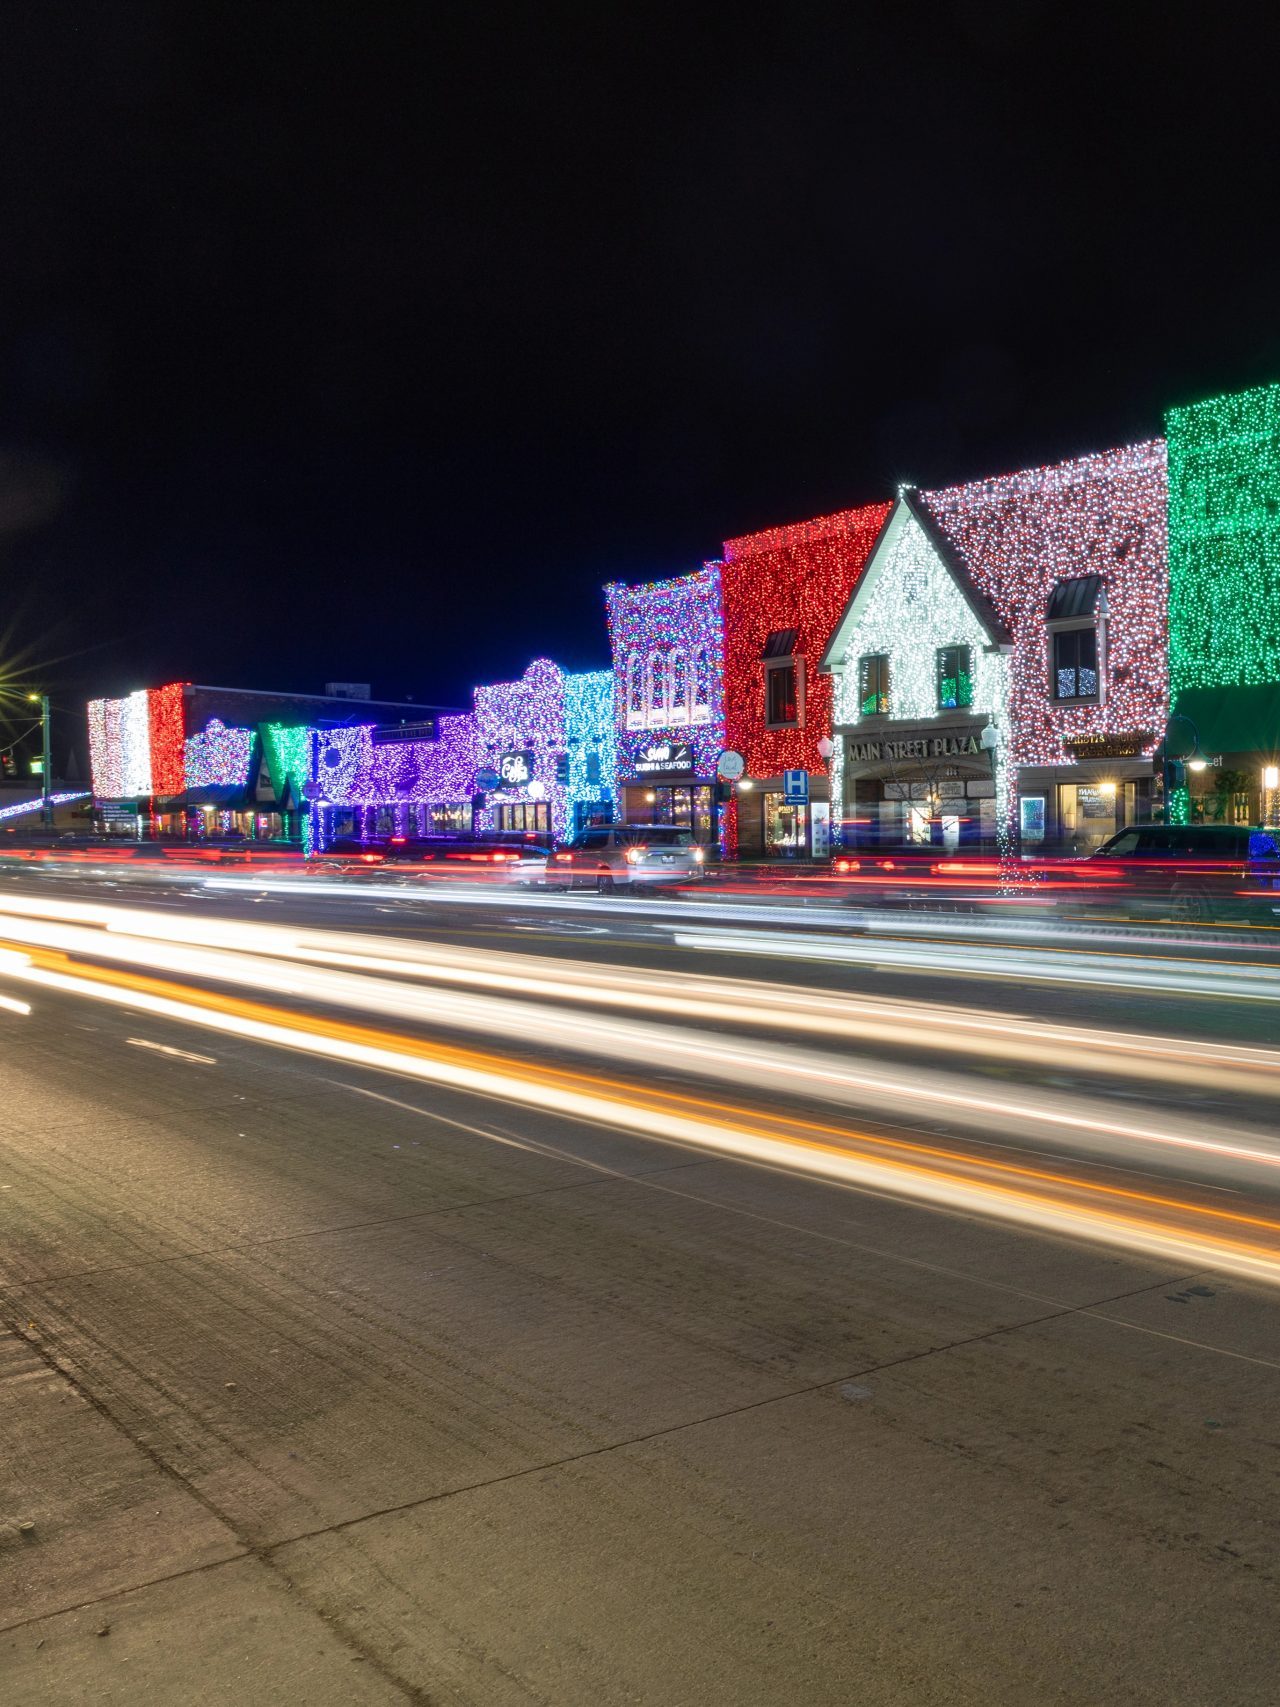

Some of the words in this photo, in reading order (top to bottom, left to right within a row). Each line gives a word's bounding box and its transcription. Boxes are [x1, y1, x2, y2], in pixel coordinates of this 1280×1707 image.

[849, 742, 881, 761] MAIN
[885, 740, 928, 759] STREET
[934, 736, 978, 757] PLAZA
[660, 761, 692, 770] SEAFOOD
[787, 771, 806, 794] H
